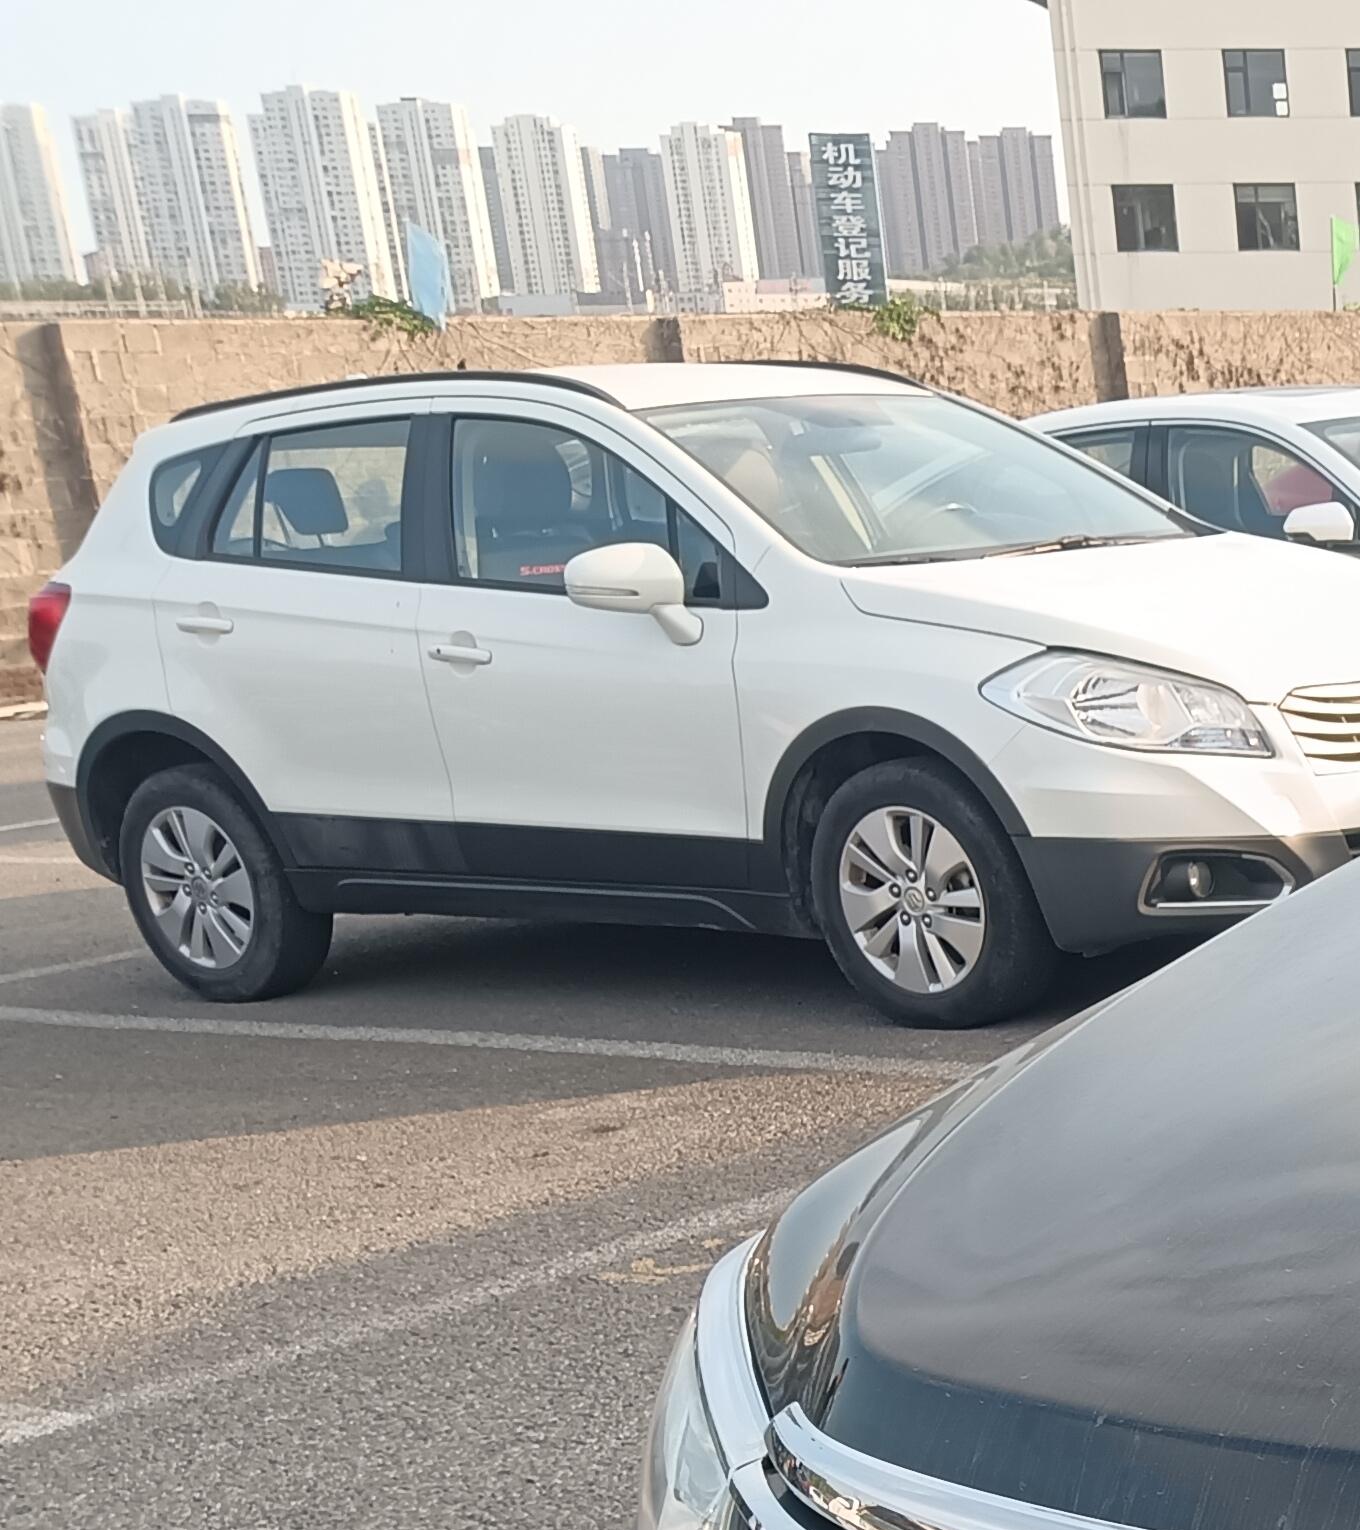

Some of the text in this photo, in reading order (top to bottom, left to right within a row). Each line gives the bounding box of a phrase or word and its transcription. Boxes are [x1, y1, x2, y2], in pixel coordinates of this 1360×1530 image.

[821, 142, 875, 304] 机动车登记服务
